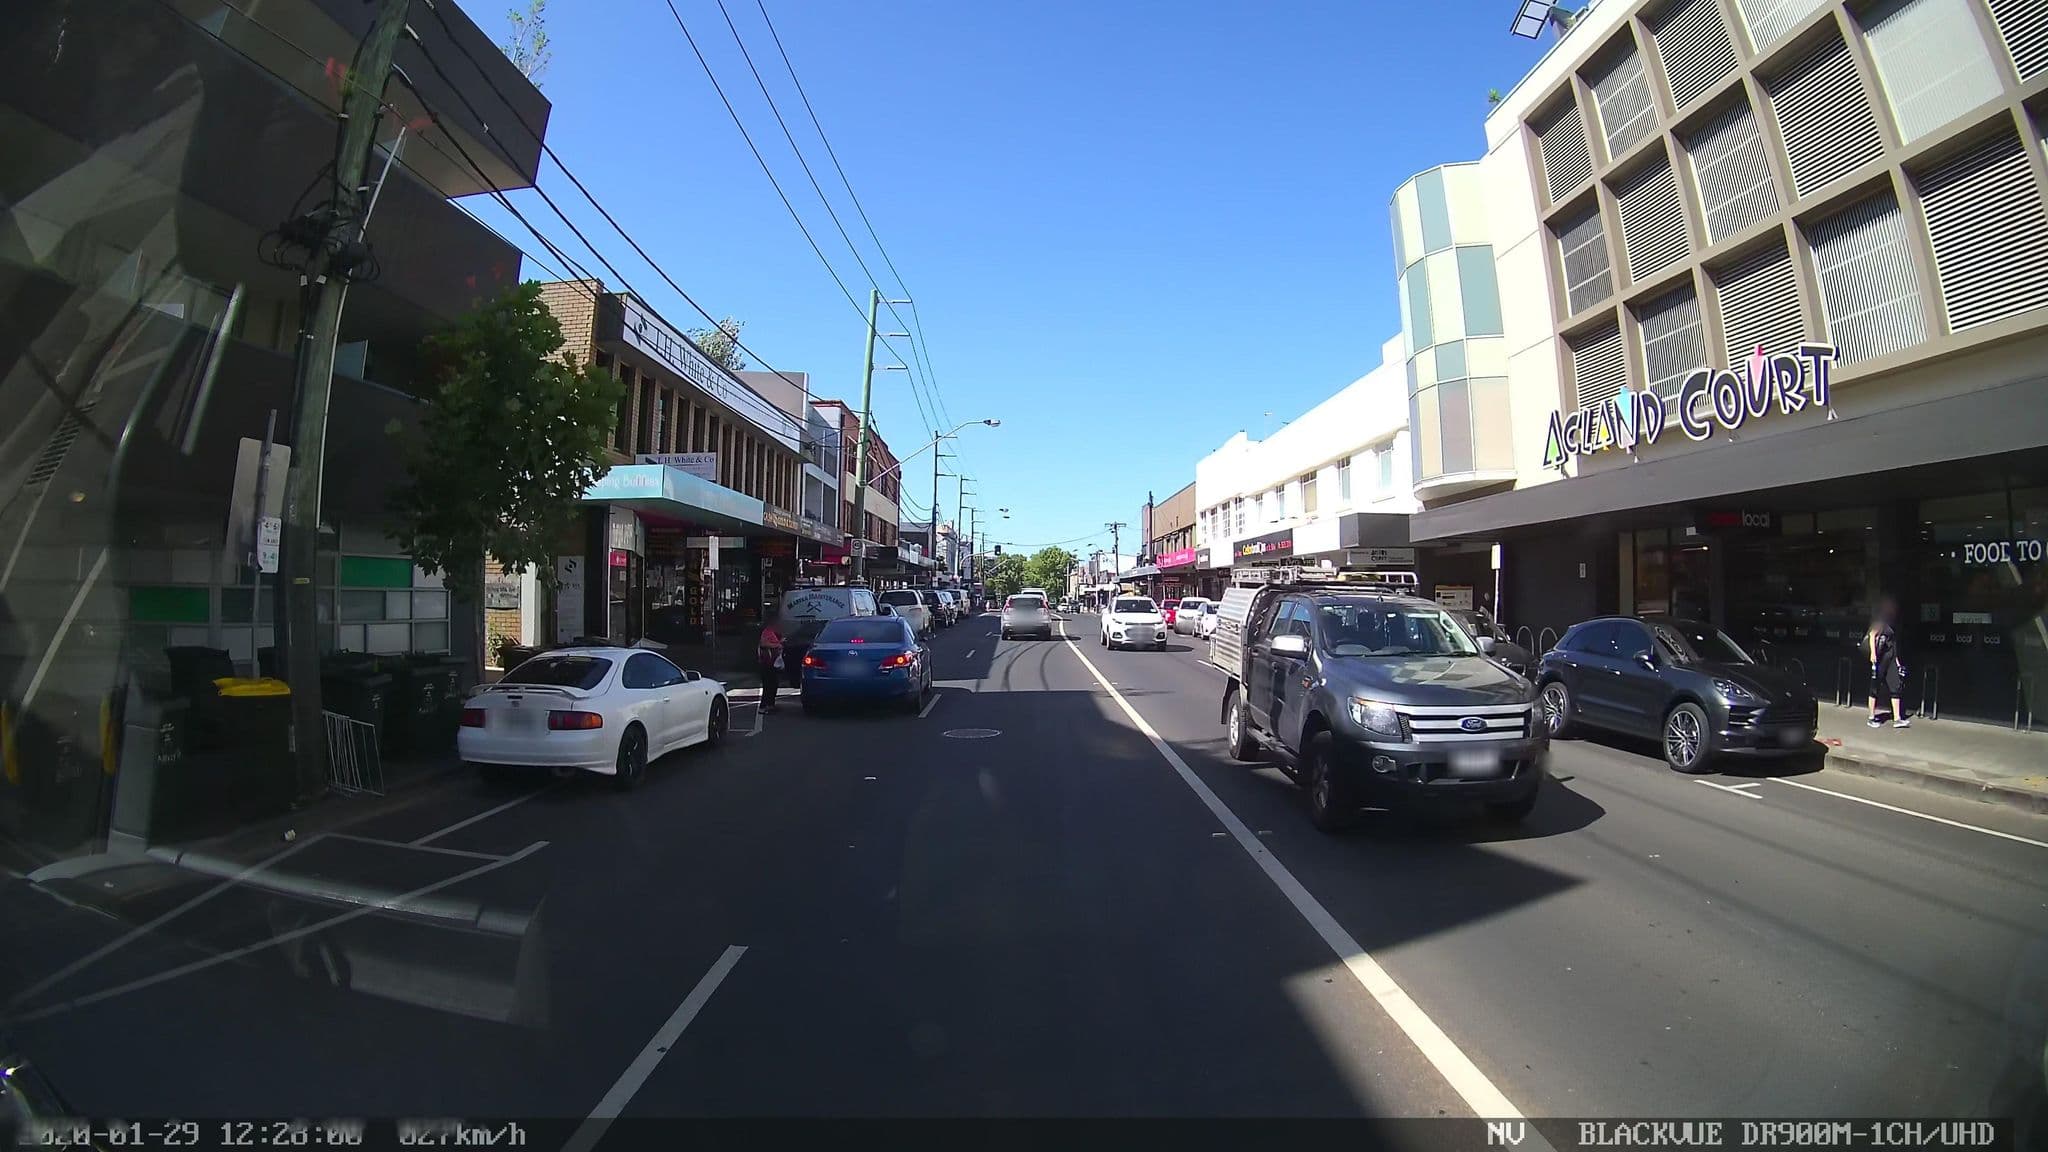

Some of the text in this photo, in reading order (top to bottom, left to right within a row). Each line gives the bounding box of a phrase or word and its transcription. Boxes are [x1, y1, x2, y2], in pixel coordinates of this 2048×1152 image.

[679, 344, 705, 384] White
[706, 367, 714, 391] &
[1543, 342, 1840, 470] ACLAND COURT
[674, 456, 695, 464] White
[695, 456, 703, 464] &
[1742, 509, 1770, 528] local
[2016, 540, 2042, 562] TO
